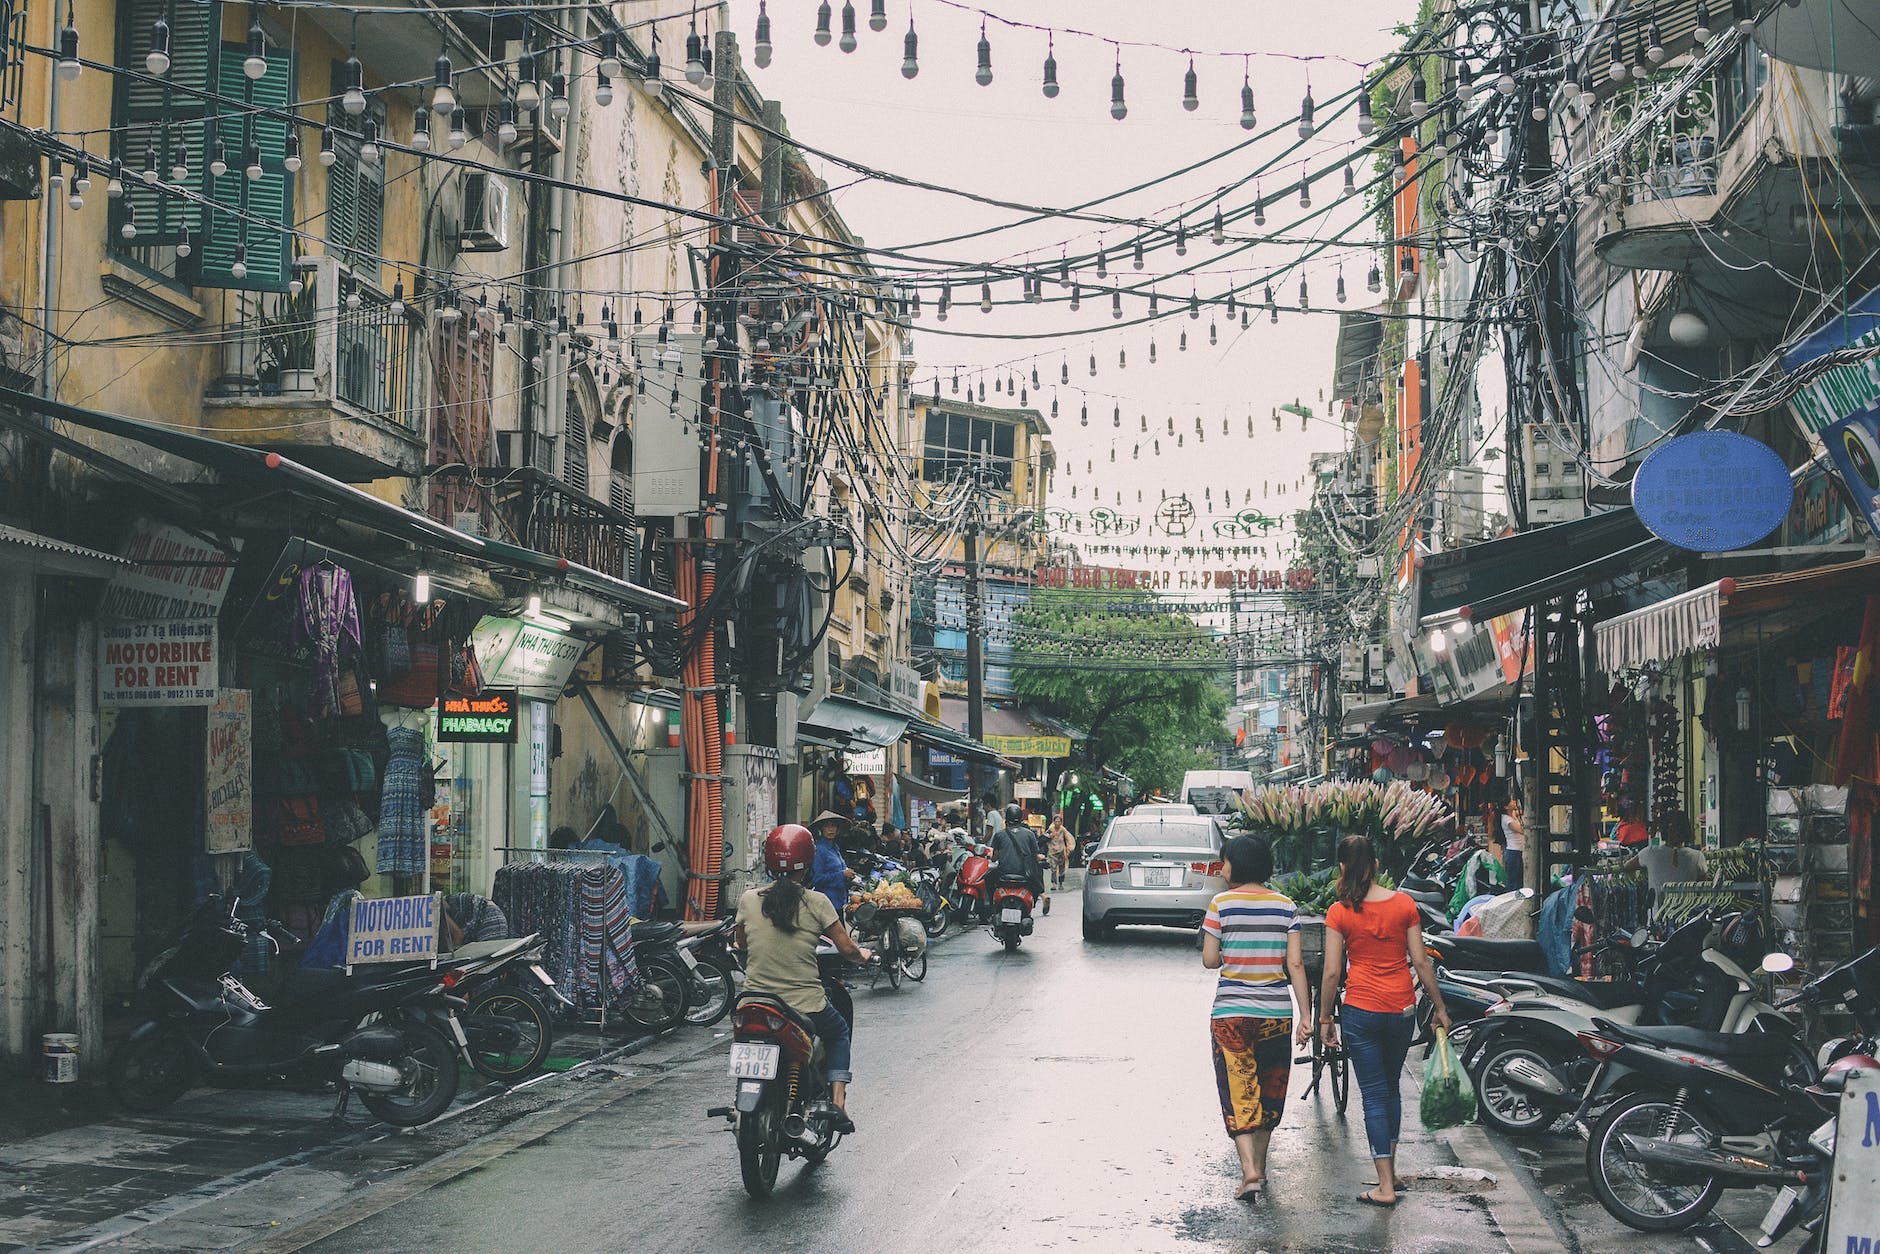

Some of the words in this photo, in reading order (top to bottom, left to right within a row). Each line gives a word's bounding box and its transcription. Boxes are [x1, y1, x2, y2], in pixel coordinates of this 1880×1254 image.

[134, 624, 149, 638] 37
[152, 624, 166, 640] Tạ
[106, 641, 211, 664] MOTORBIKE
[517, 632, 540, 651] NHÀ
[537, 637, 568, 658] THUỐC
[114, 666, 149, 688] FOR
[155, 665, 200, 687] RENT
[167, 689, 184, 699] 0912
[186, 689, 194, 698] 11
[195, 689, 204, 698] 55
[471, 696, 509, 713] THUỐC
[442, 717, 512, 733] PHARMACY
[354, 896, 434, 933] MOTORBIKE
[353, 939, 385, 958] FOR
[390, 936, 433, 955] RENT
[736, 1046, 772, 1061] 29-U7
[735, 1061, 770, 1076] 8105
